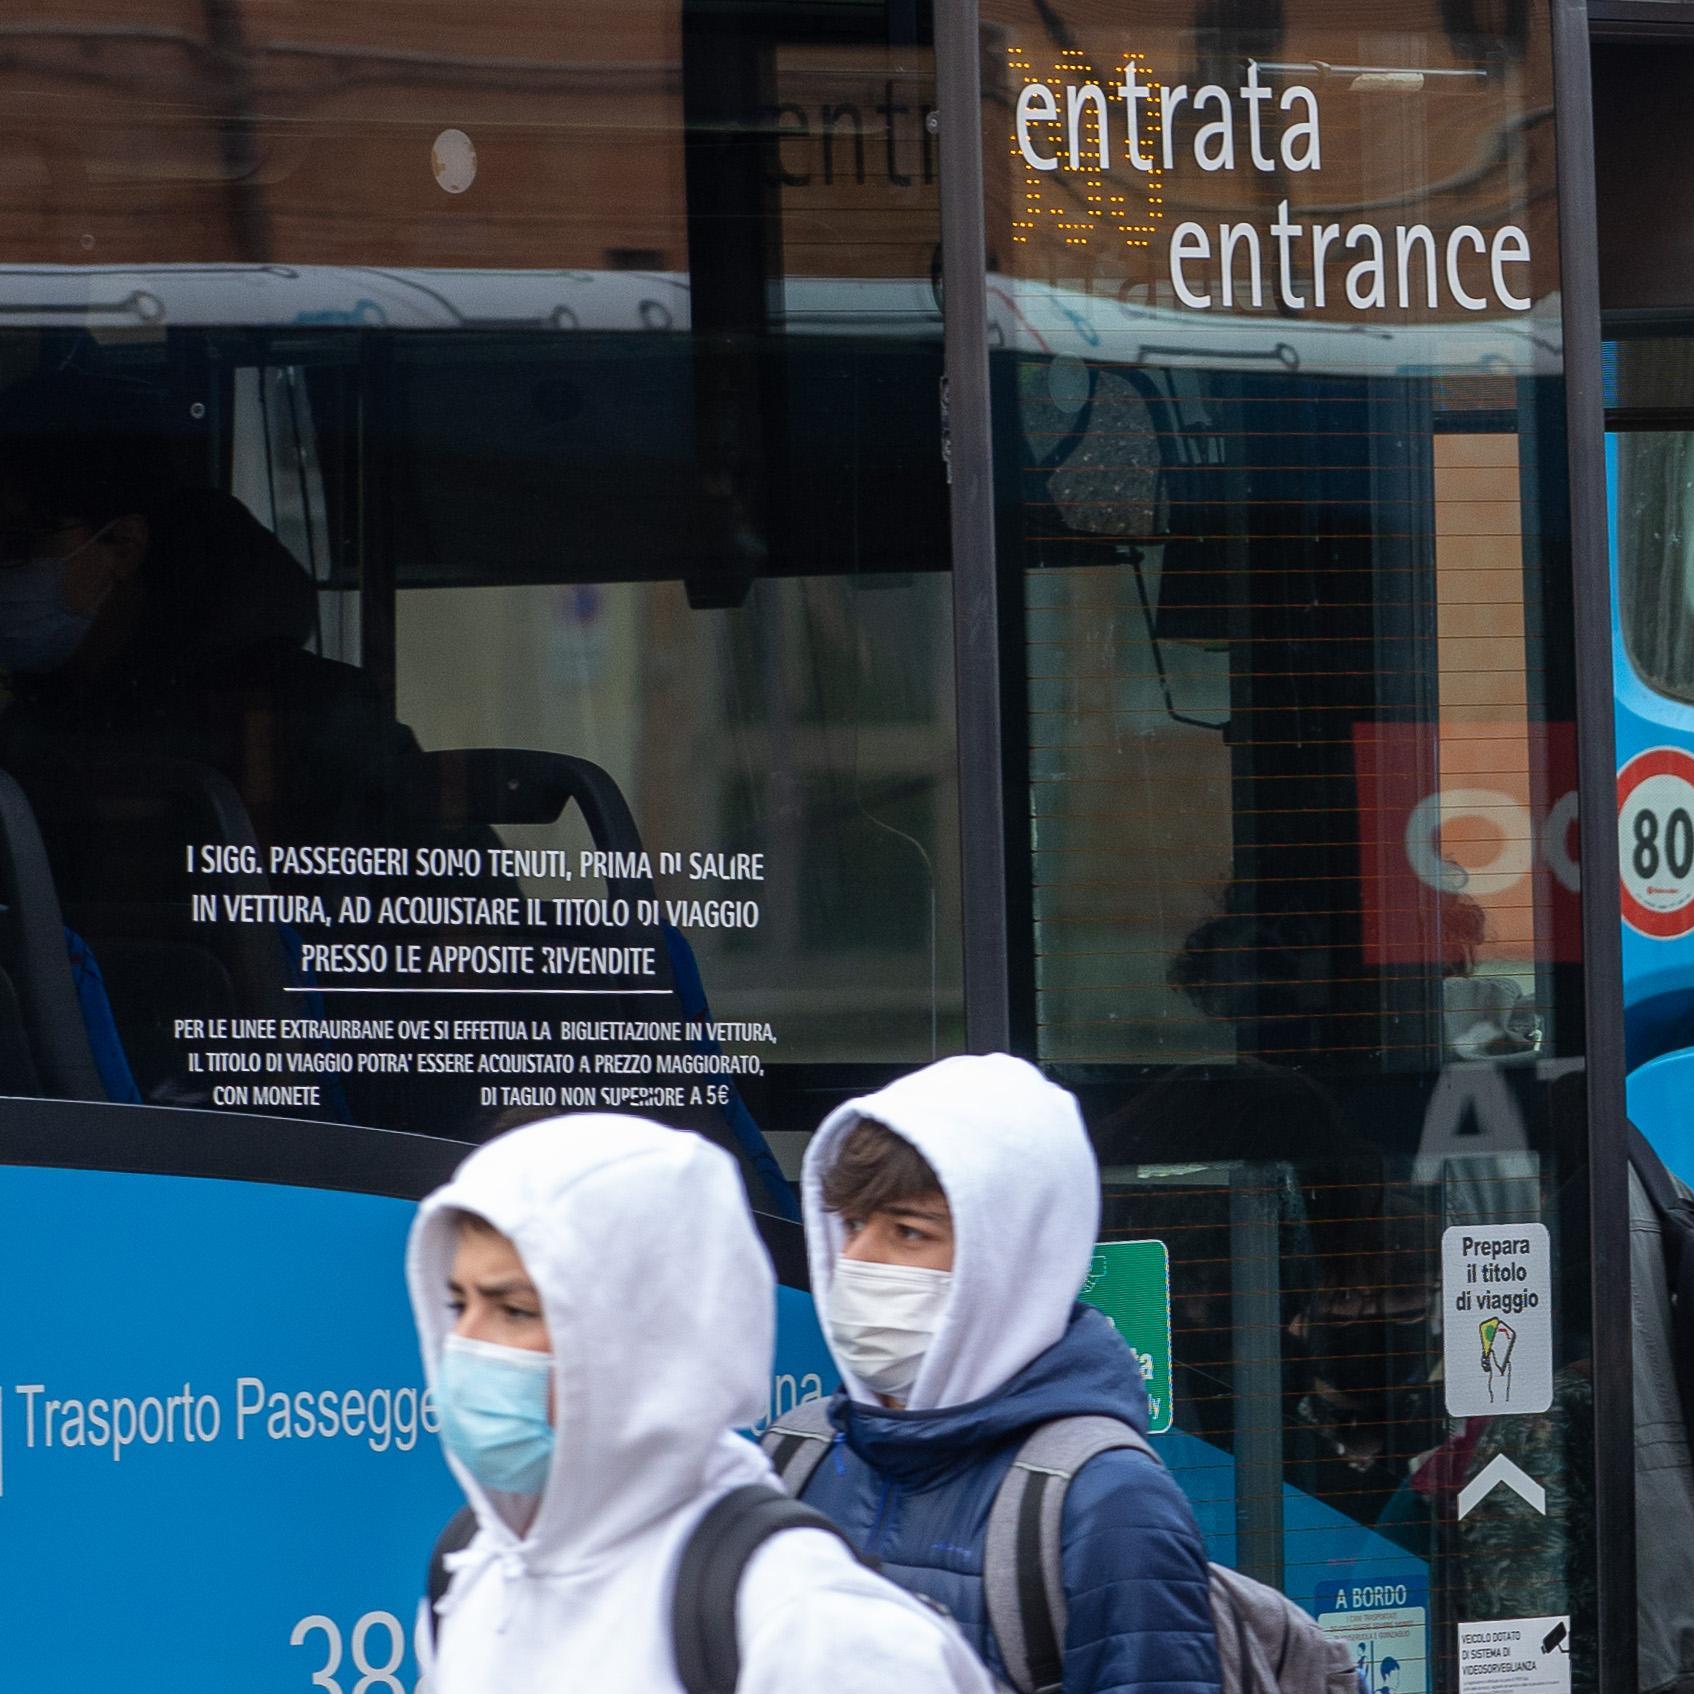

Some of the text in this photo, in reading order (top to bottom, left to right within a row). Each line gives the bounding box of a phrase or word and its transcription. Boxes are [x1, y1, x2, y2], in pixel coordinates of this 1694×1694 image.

[1015, 58, 1322, 172] entrata
[1168, 199, 1533, 311] entrance
[1633, 808, 1694, 879] 80
[187, 846, 193, 872] I
[202, 845, 262, 873] SIGG.
[271, 847, 407, 875] PASSEGGERI
[416, 848, 480, 876] SONO
[488, 850, 571, 881] TENUTI,
[580, 851, 652, 878] PRIMA
[690, 852, 763, 880] SALIRE
[193, 895, 758, 927] IN VETTURA, AD ACQUISTARE IL TITOLO DI VIAGGIO
[302, 944, 655, 974] PRESSO LE APPOSITE RIVENDITE
[175, 1020, 776, 1043] PER LE LINEE EXTRAURBANE OVE SI EFFETTUA LA BIGLIETTAZIONE IN VETTURA,
[189, 1053, 204, 1072] IL
[206, 1053, 260, 1072] TITOLO
[266, 1053, 282, 1071] DI
[286, 1053, 352, 1072] VIAGGIO
[358, 1054, 412, 1072] POTRA'
[418, 1054, 473, 1072] ESSERE
[478, 1054, 574, 1073] ACQUISTATO
[580, 1056, 590, 1073] A
[595, 1055, 651, 1073] PREZZO
[214, 1086, 247, 1105] CON
[254, 1086, 320, 1105] MONETE
[481, 1087, 496, 1105] DI
[501, 1087, 556, 1106] TAGLIO
[562, 1087, 595, 1105] NON
[690, 1086, 702, 1104] A
[707, 1085, 728, 1104] 5€
[1462, 1237, 1530, 1259] Prepara
[1467, 1262, 1526, 1283] il titolo
[1456, 1288, 1538, 1313] di viaggio
[16, 1377, 443, 1461] Trasporto Passegge
[1336, 1585, 1406, 1609] A BORDO
[1461, 1631, 1521, 1644] VEICOLO DOTATO
[1462, 1647, 1511, 1660] DI SISTEMA DI
[1462, 1661, 1537, 1676] VIDEOSORVEGLIANZA
